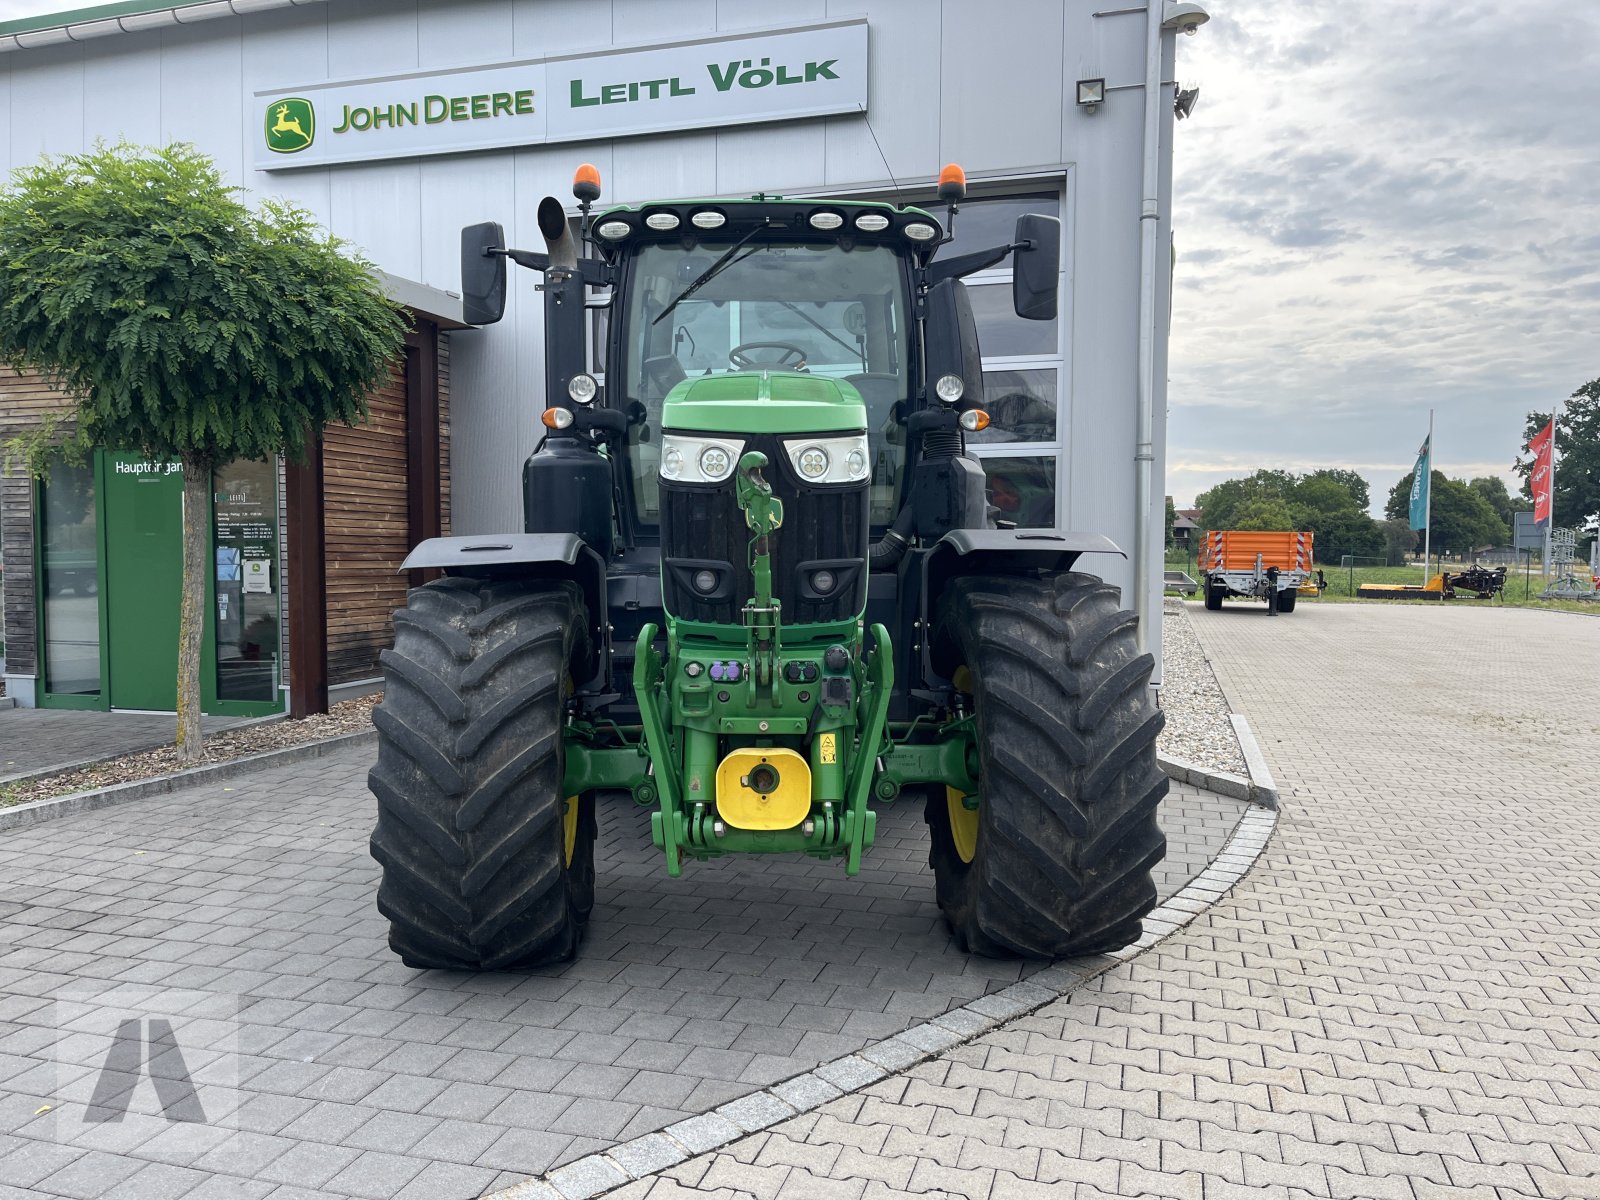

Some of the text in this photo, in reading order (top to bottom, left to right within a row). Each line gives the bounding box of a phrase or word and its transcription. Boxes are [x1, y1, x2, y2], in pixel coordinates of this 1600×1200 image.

[570, 57, 841, 108] LEITL VÖLK
[333, 89, 535, 133] JOHN DEERE
